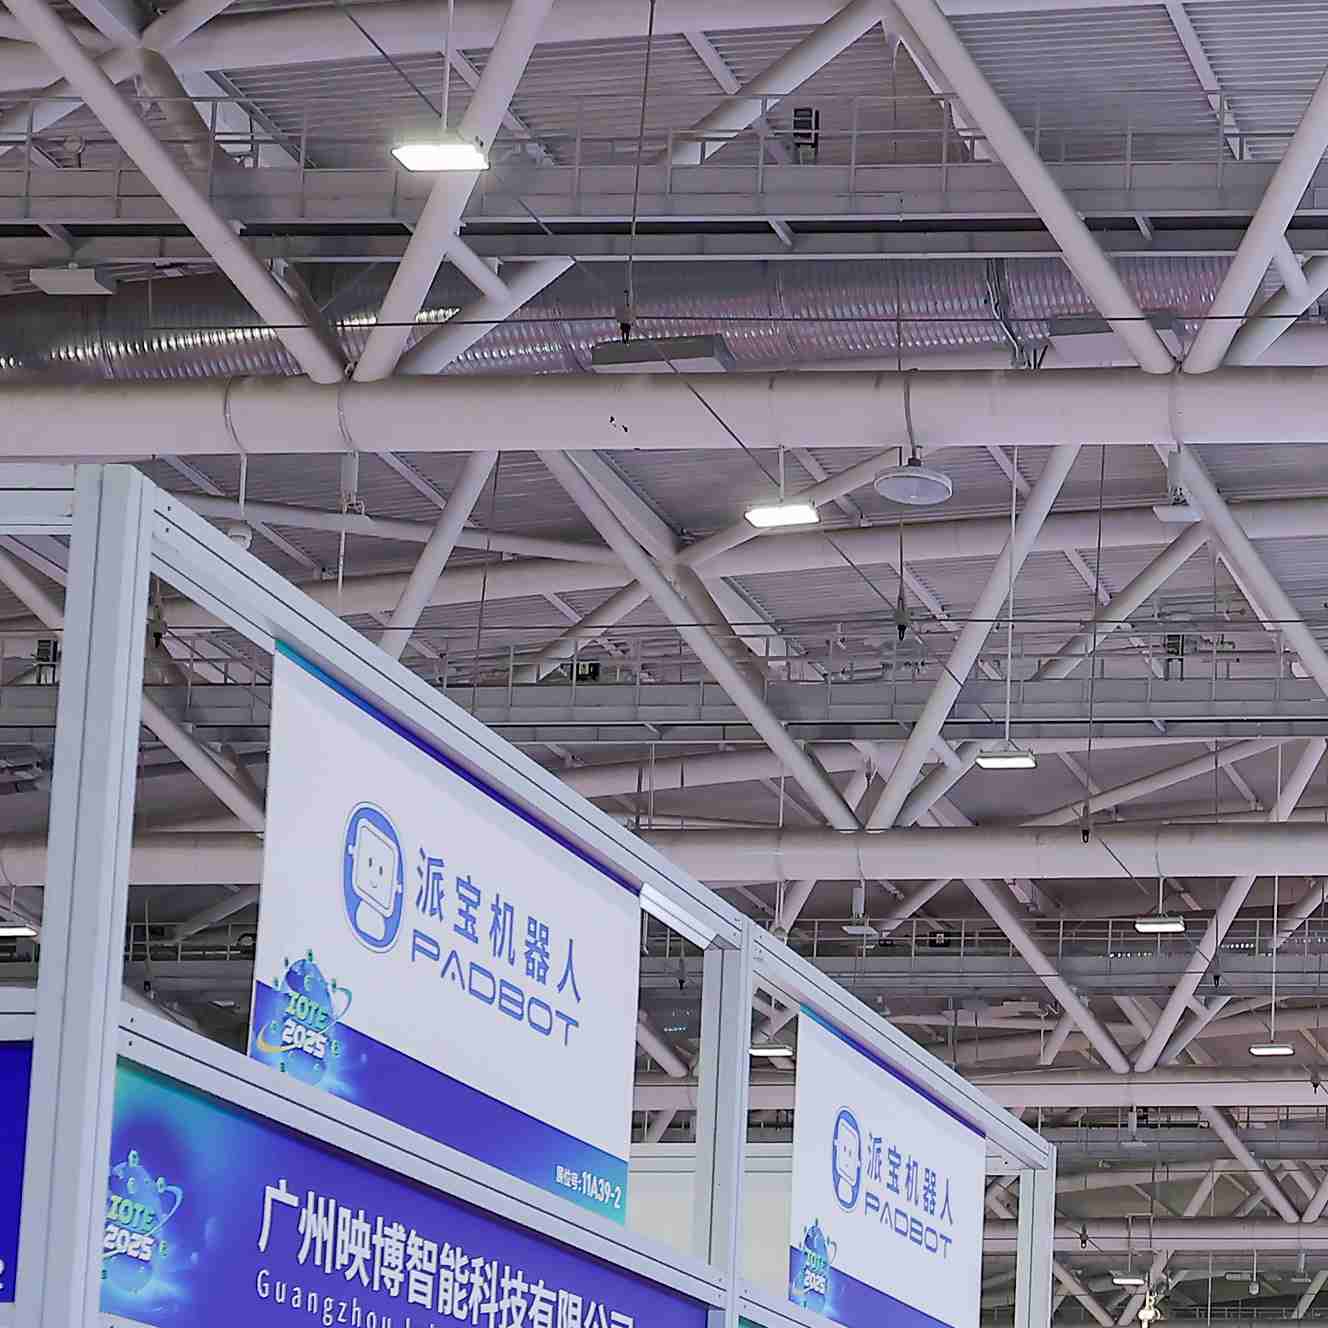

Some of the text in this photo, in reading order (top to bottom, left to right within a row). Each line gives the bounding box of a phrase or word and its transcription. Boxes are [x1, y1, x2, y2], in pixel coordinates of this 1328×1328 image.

[415, 847, 582, 1004] 派宝机器人
[410, 929, 580, 1048] PADBOT
[281, 1018, 328, 1059] 2025
[867, 1132, 955, 1228] 派宝机器人
[104, 1225, 154, 1262] 2025
[863, 1190, 953, 1261] PADBOT
